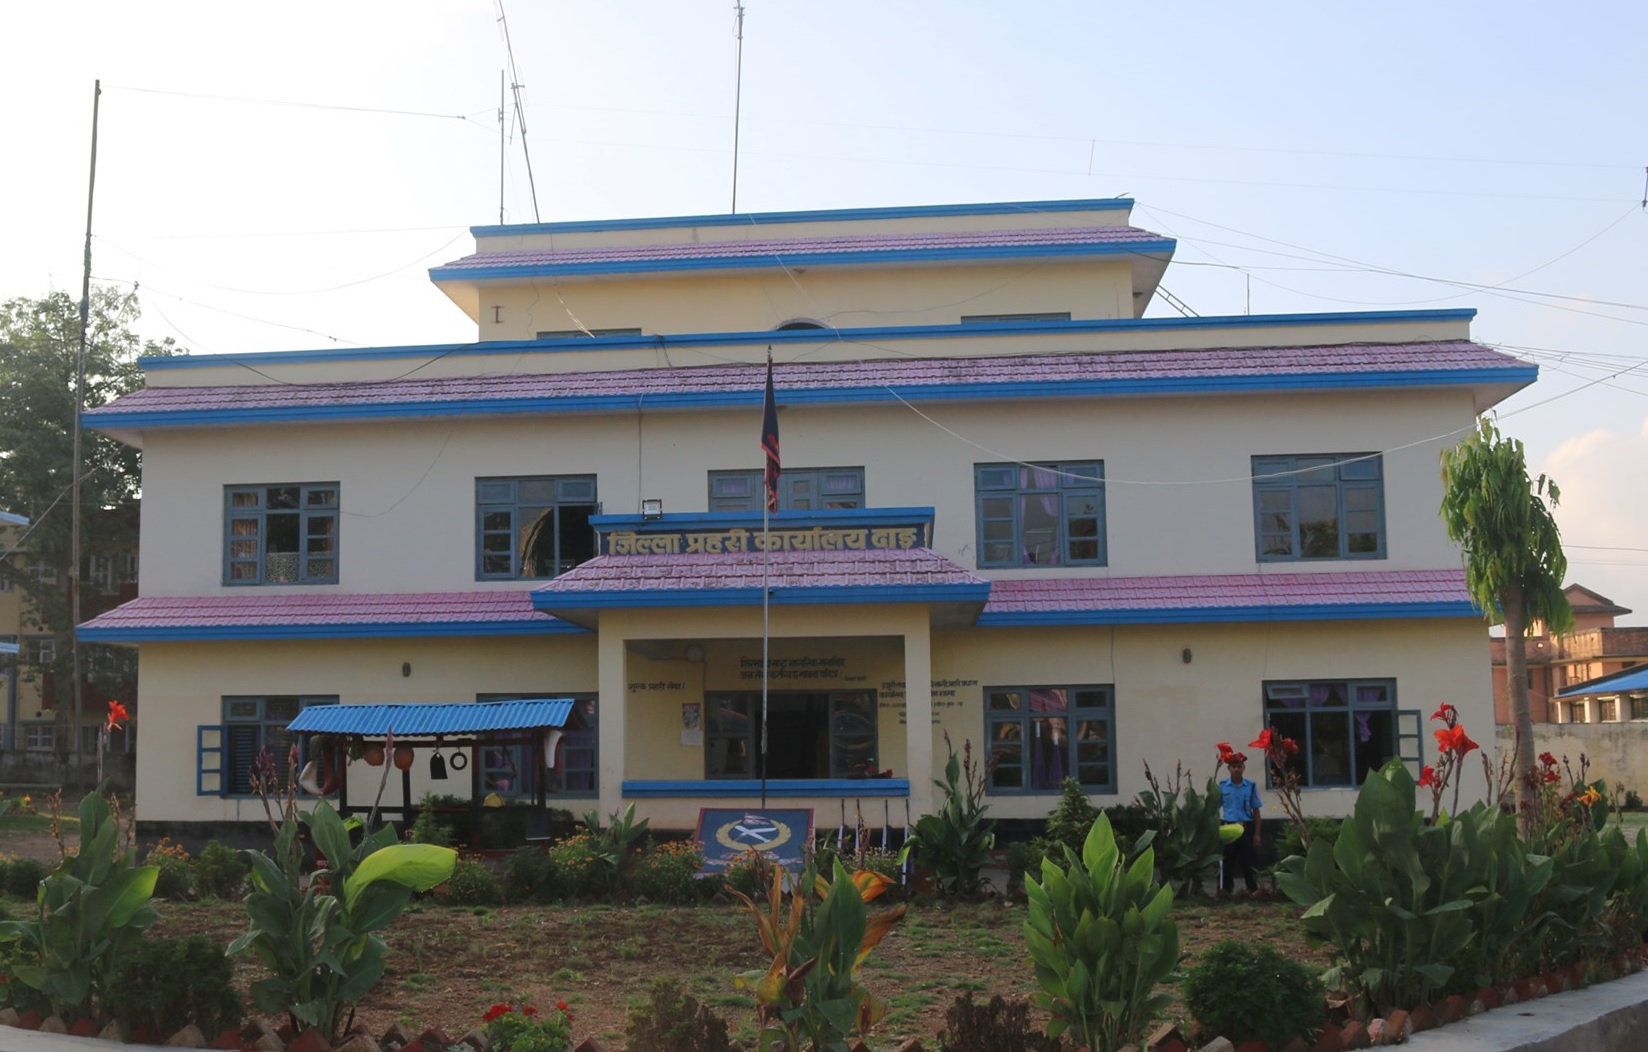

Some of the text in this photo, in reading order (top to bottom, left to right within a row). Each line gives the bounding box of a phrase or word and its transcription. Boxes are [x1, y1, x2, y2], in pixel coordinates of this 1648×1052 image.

[607, 526, 918, 555] जिल्ला प्रहरी कार्यालय दाङ
